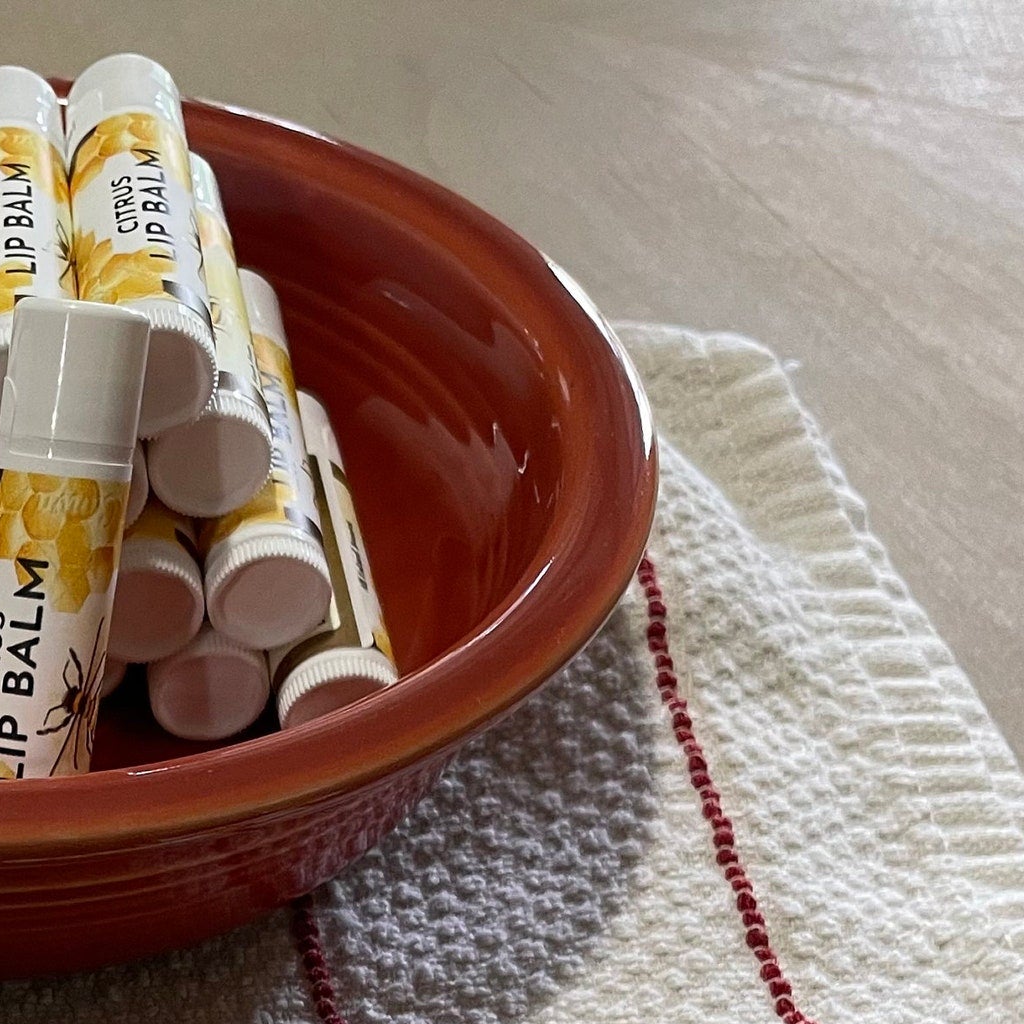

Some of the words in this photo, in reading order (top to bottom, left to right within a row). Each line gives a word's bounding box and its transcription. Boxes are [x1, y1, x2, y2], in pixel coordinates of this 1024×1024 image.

[0, 163, 34, 228] BALM
[111, 175, 138, 234] CITRUS
[131, 148, 171, 215] BALM
[4, 237, 36, 275] LIP
[145, 222, 176, 260] LIP
[2, 557, 50, 697] BALM
